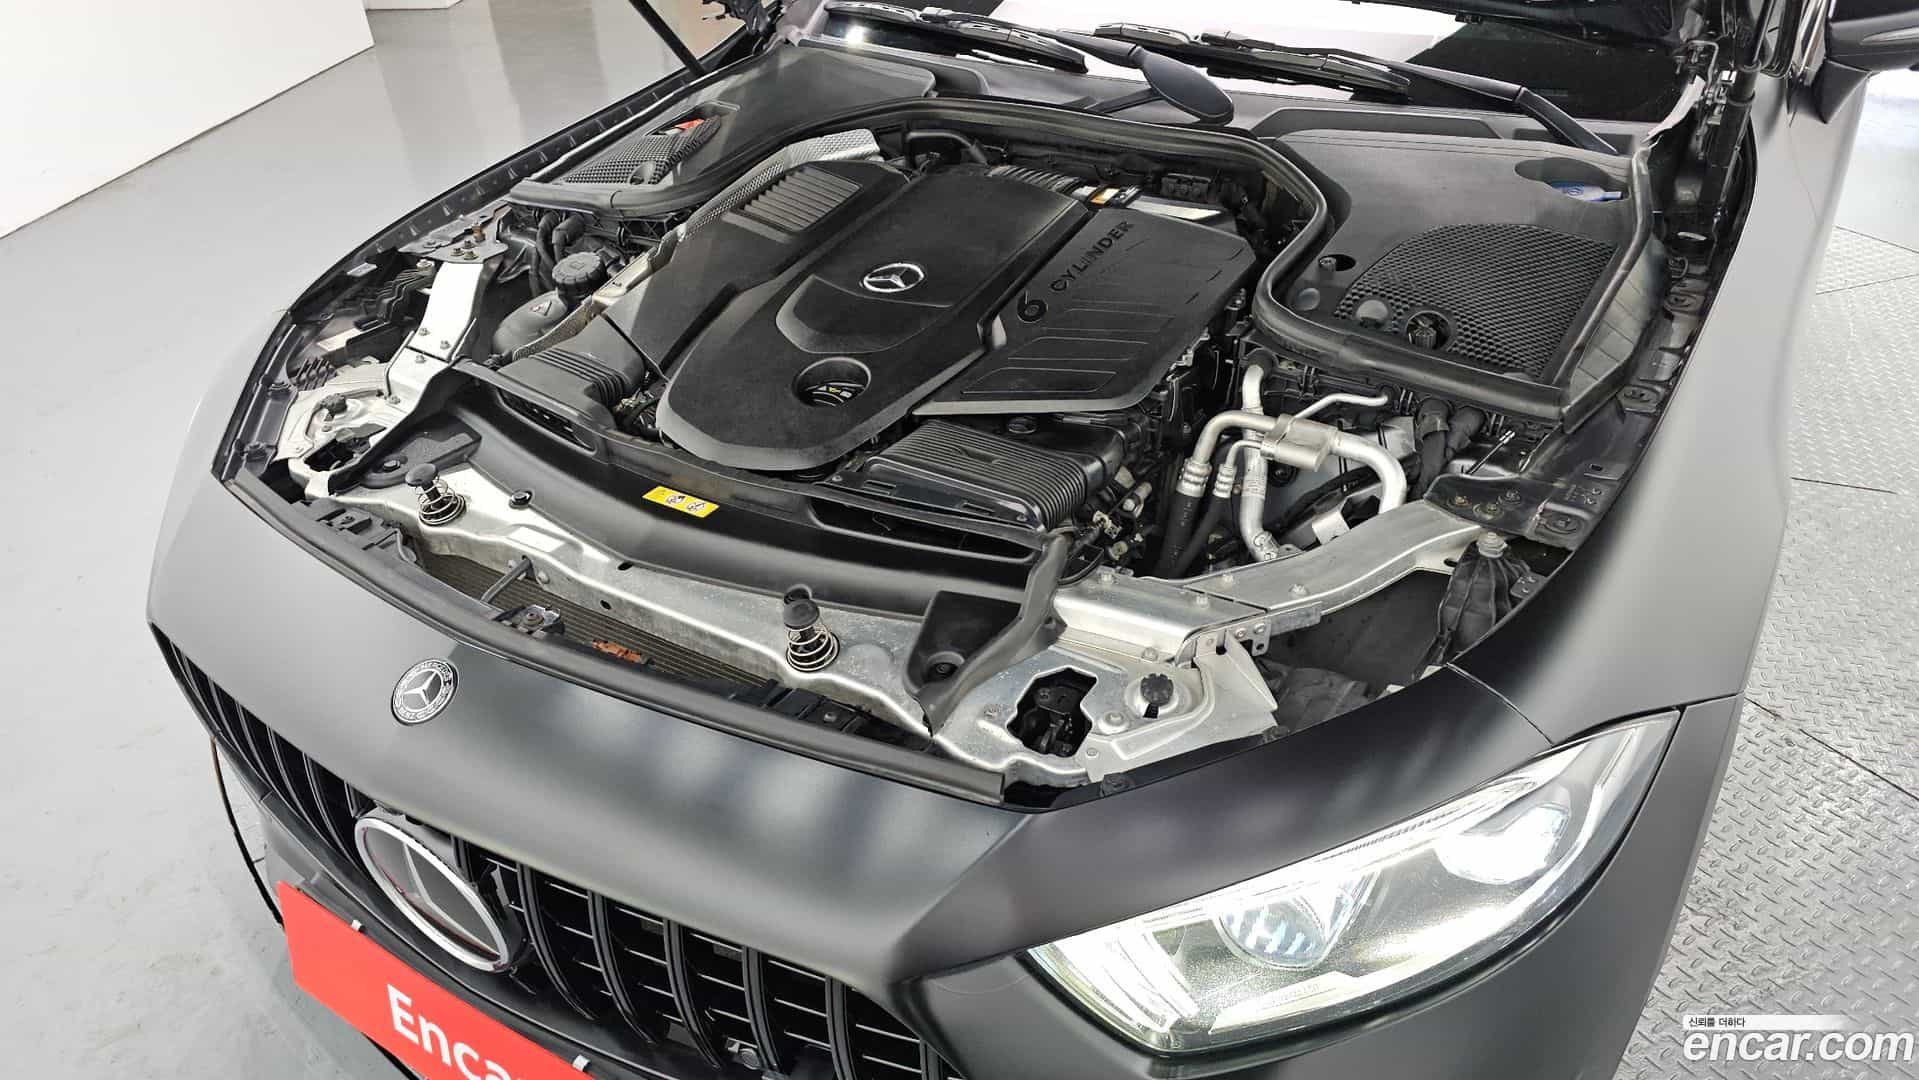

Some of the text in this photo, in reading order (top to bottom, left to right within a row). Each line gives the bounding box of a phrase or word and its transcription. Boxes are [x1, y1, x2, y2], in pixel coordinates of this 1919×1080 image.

[1017, 220, 1134, 323] 6 CYLINDER
[386, 983, 521, 1080] Enca
